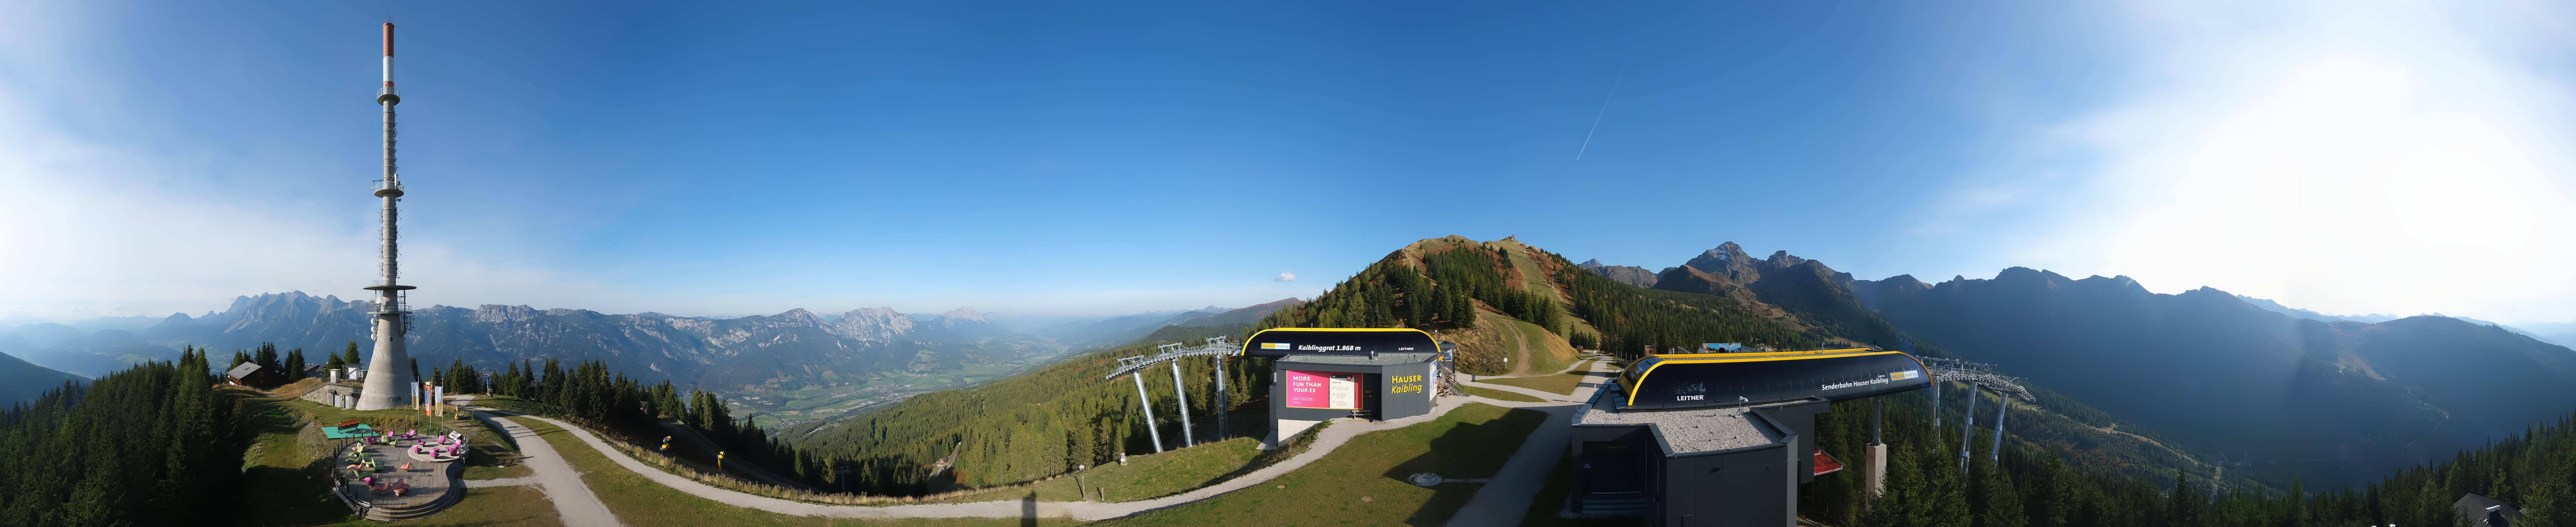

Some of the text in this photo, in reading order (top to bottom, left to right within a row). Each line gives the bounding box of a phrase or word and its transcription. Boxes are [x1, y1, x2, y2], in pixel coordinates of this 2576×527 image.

[1392, 375, 1421, 384] HAUSER
[1391, 384, 1422, 394] Kaibling
[1822, 382, 1852, 390] Senderbahn
